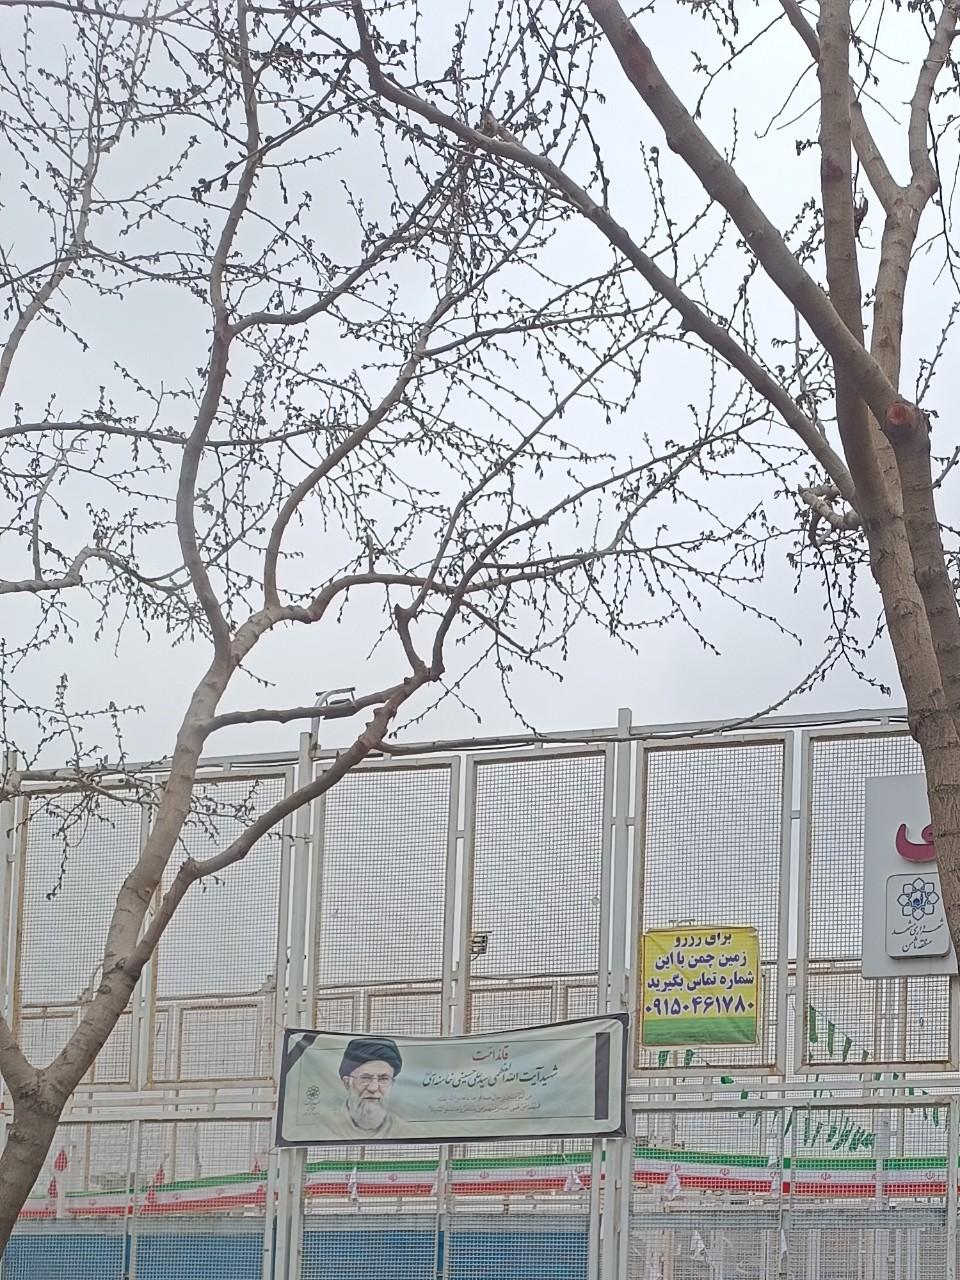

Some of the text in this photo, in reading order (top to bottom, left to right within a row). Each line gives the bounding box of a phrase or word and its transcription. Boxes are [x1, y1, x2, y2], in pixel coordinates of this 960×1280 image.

[891, 917, 945, 937] شهرداری مشهد
[704, 931, 732, 947] برای
[655, 950, 748, 970] زمین چمن با این
[647, 970, 755, 993] شماره تماس بگیرید
